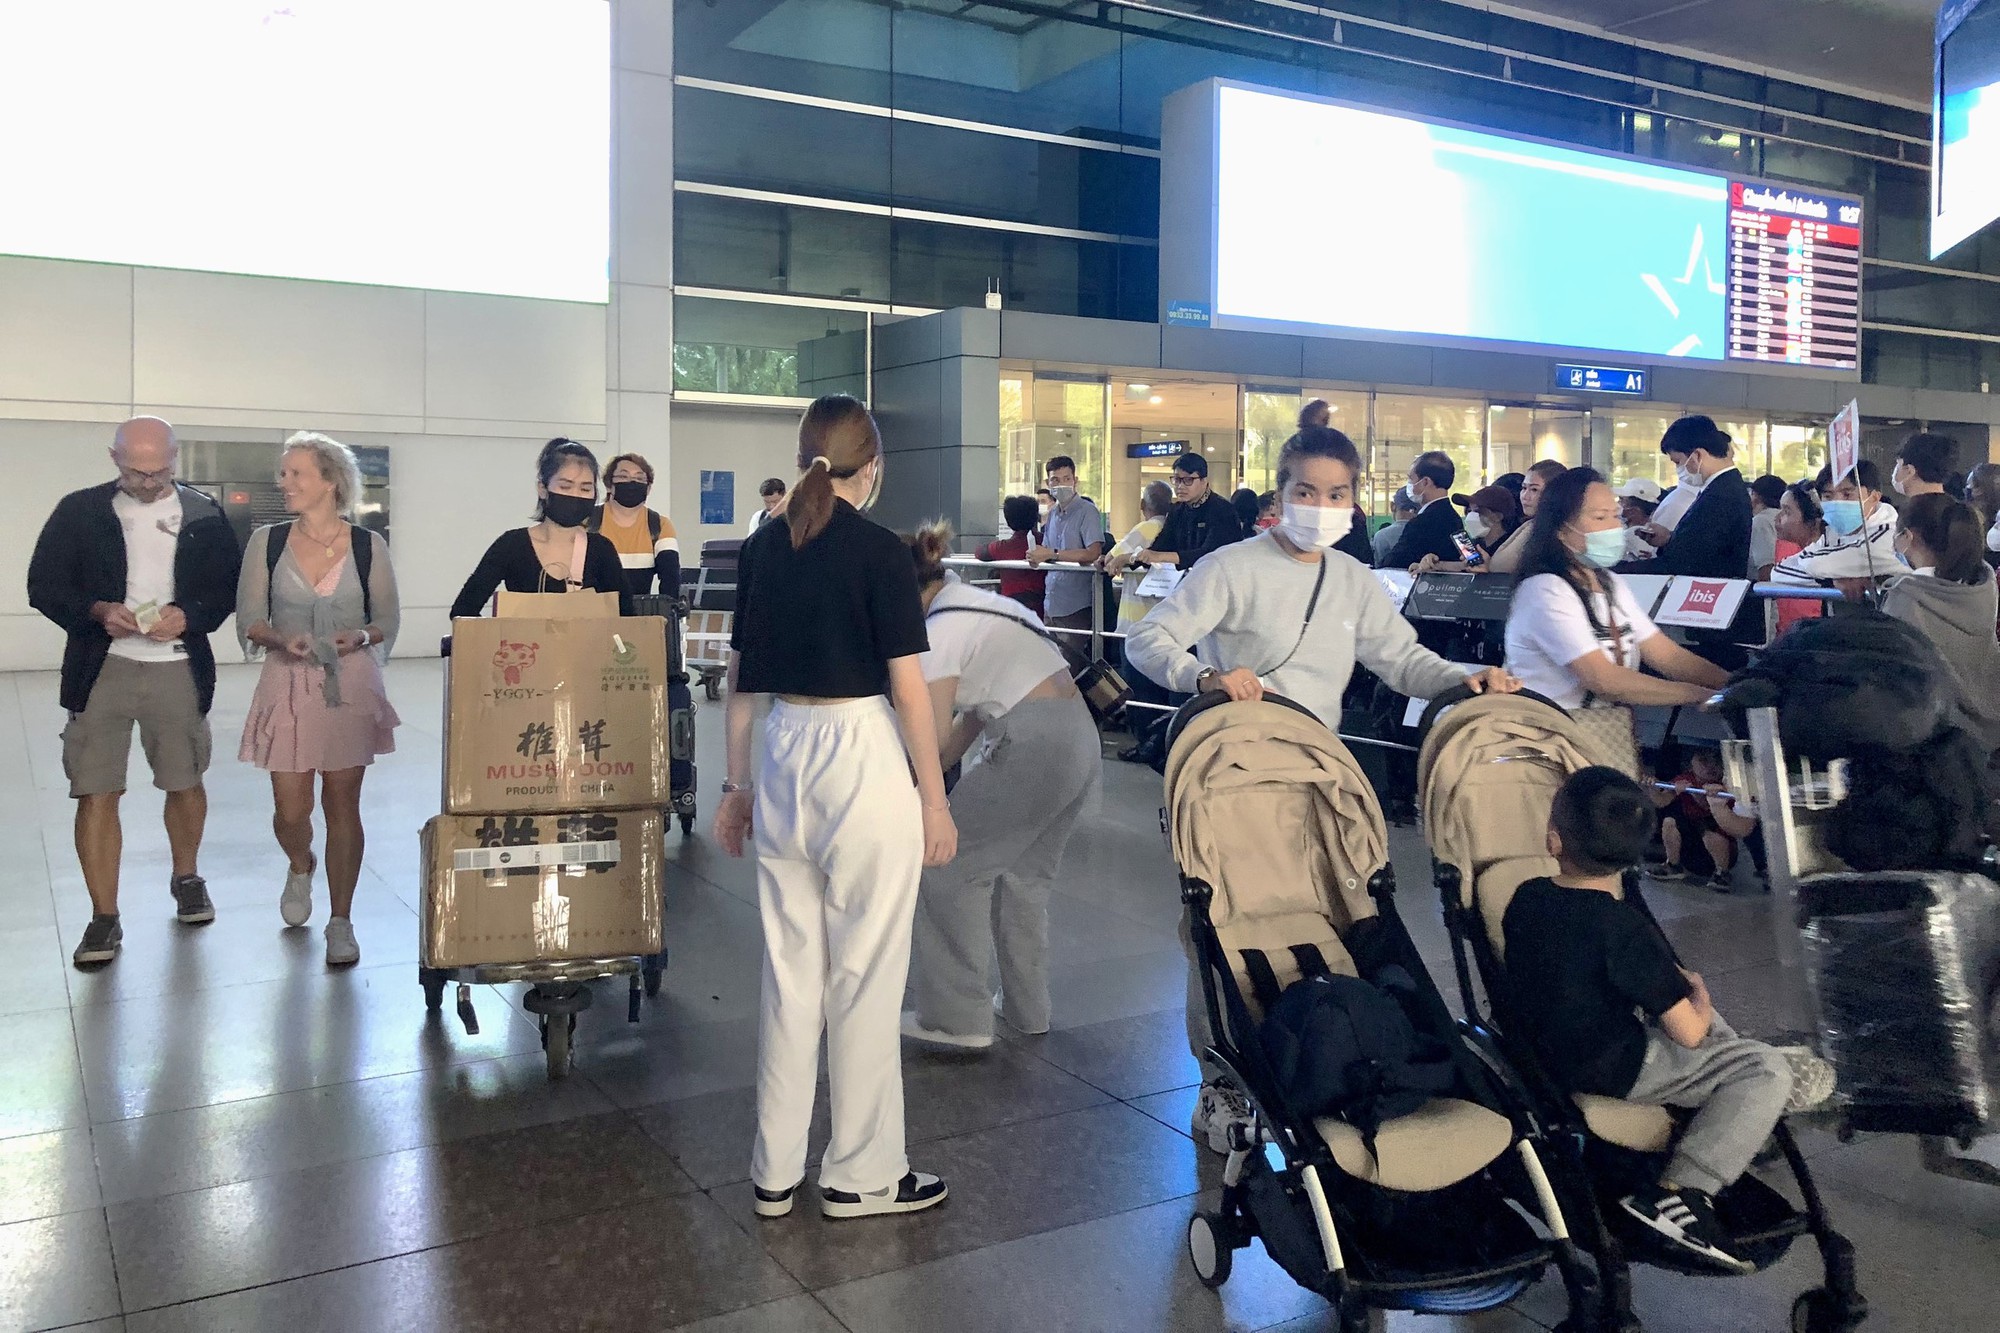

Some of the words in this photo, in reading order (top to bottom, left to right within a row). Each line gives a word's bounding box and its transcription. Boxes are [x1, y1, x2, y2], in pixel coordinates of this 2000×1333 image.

[1626, 374, 1642, 390] A1
[1688, 588, 1716, 604] ibis
[486, 761, 634, 780] MUSHOOM
[505, 785, 559, 796] PRODUCT
[580, 783, 616, 794] CHINA
